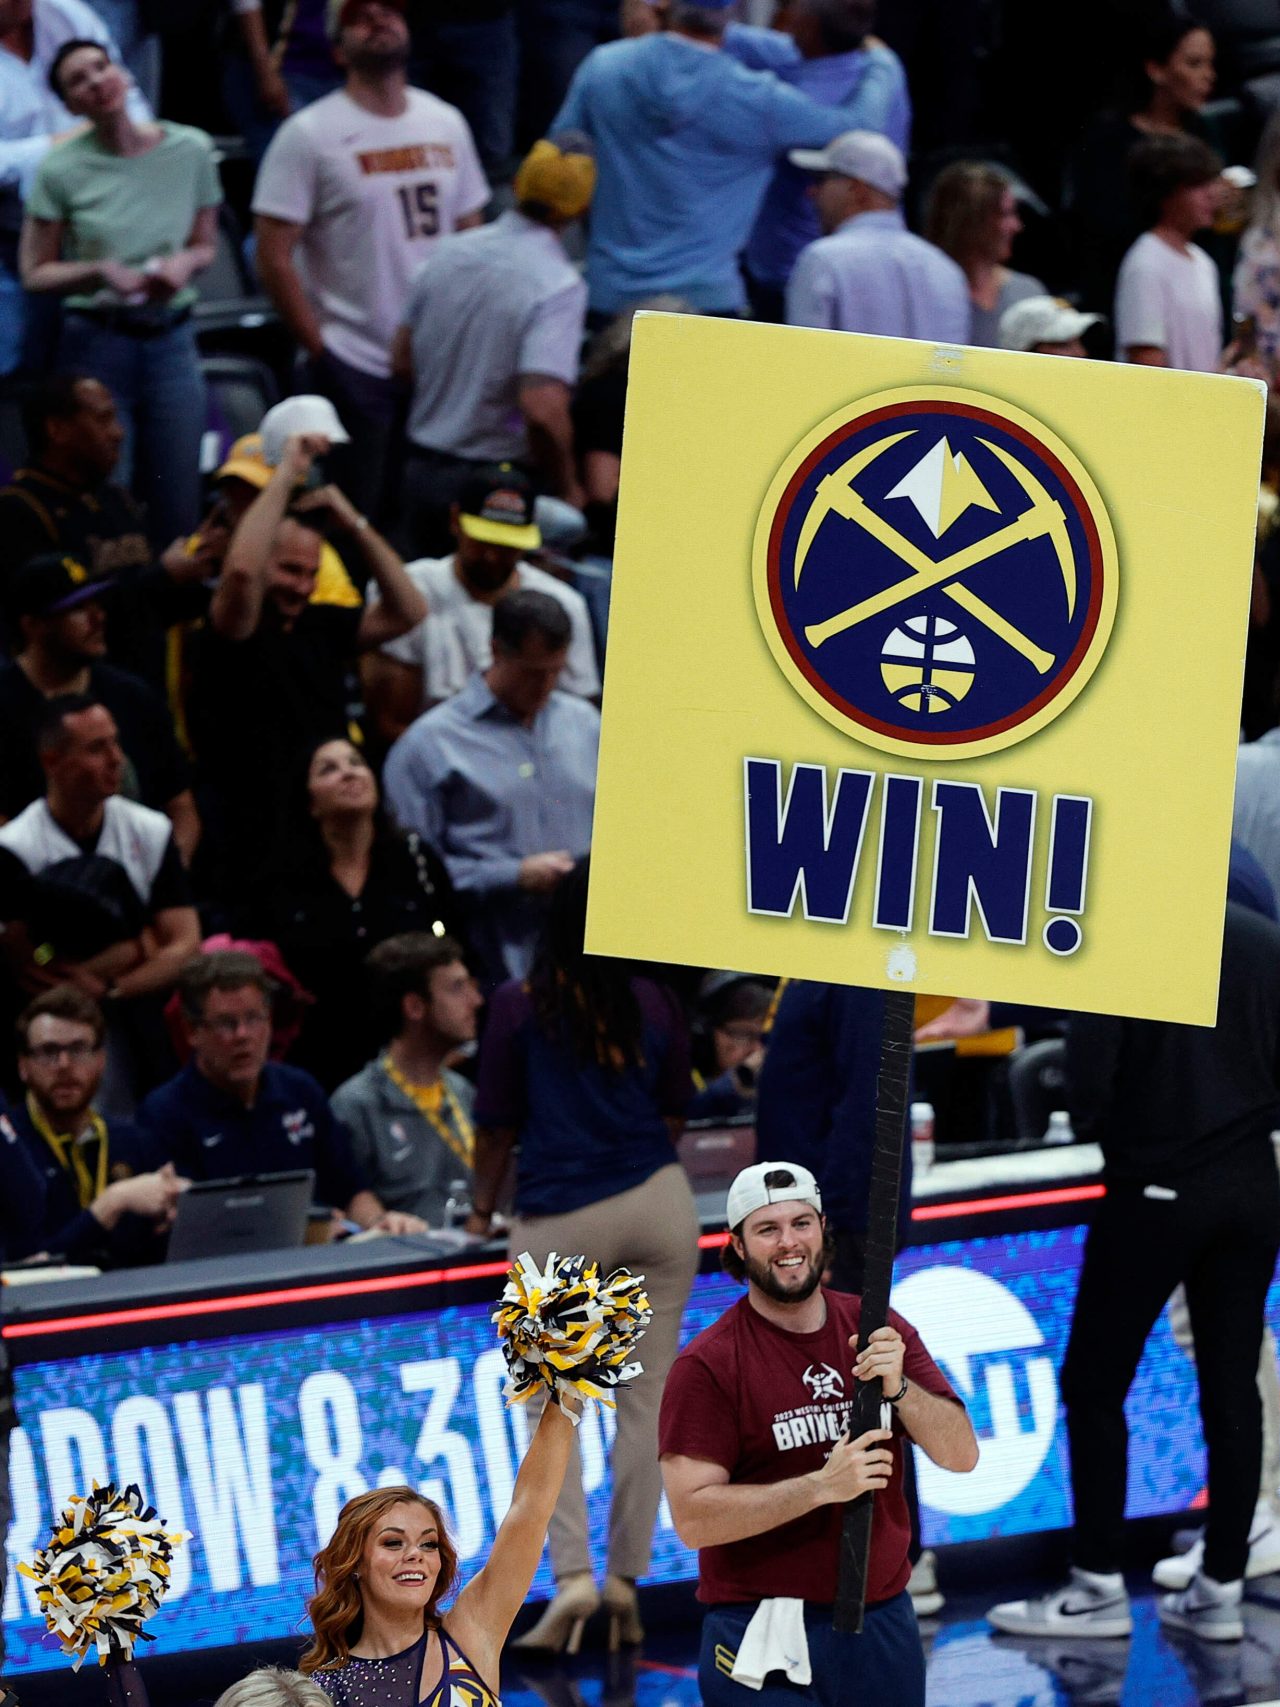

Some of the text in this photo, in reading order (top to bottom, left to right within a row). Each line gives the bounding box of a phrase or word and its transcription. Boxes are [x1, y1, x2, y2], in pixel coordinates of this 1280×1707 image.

[397, 183, 440, 239] 15
[744, 757, 1092, 956] WIN!
[772, 1411, 841, 1451] BRING
